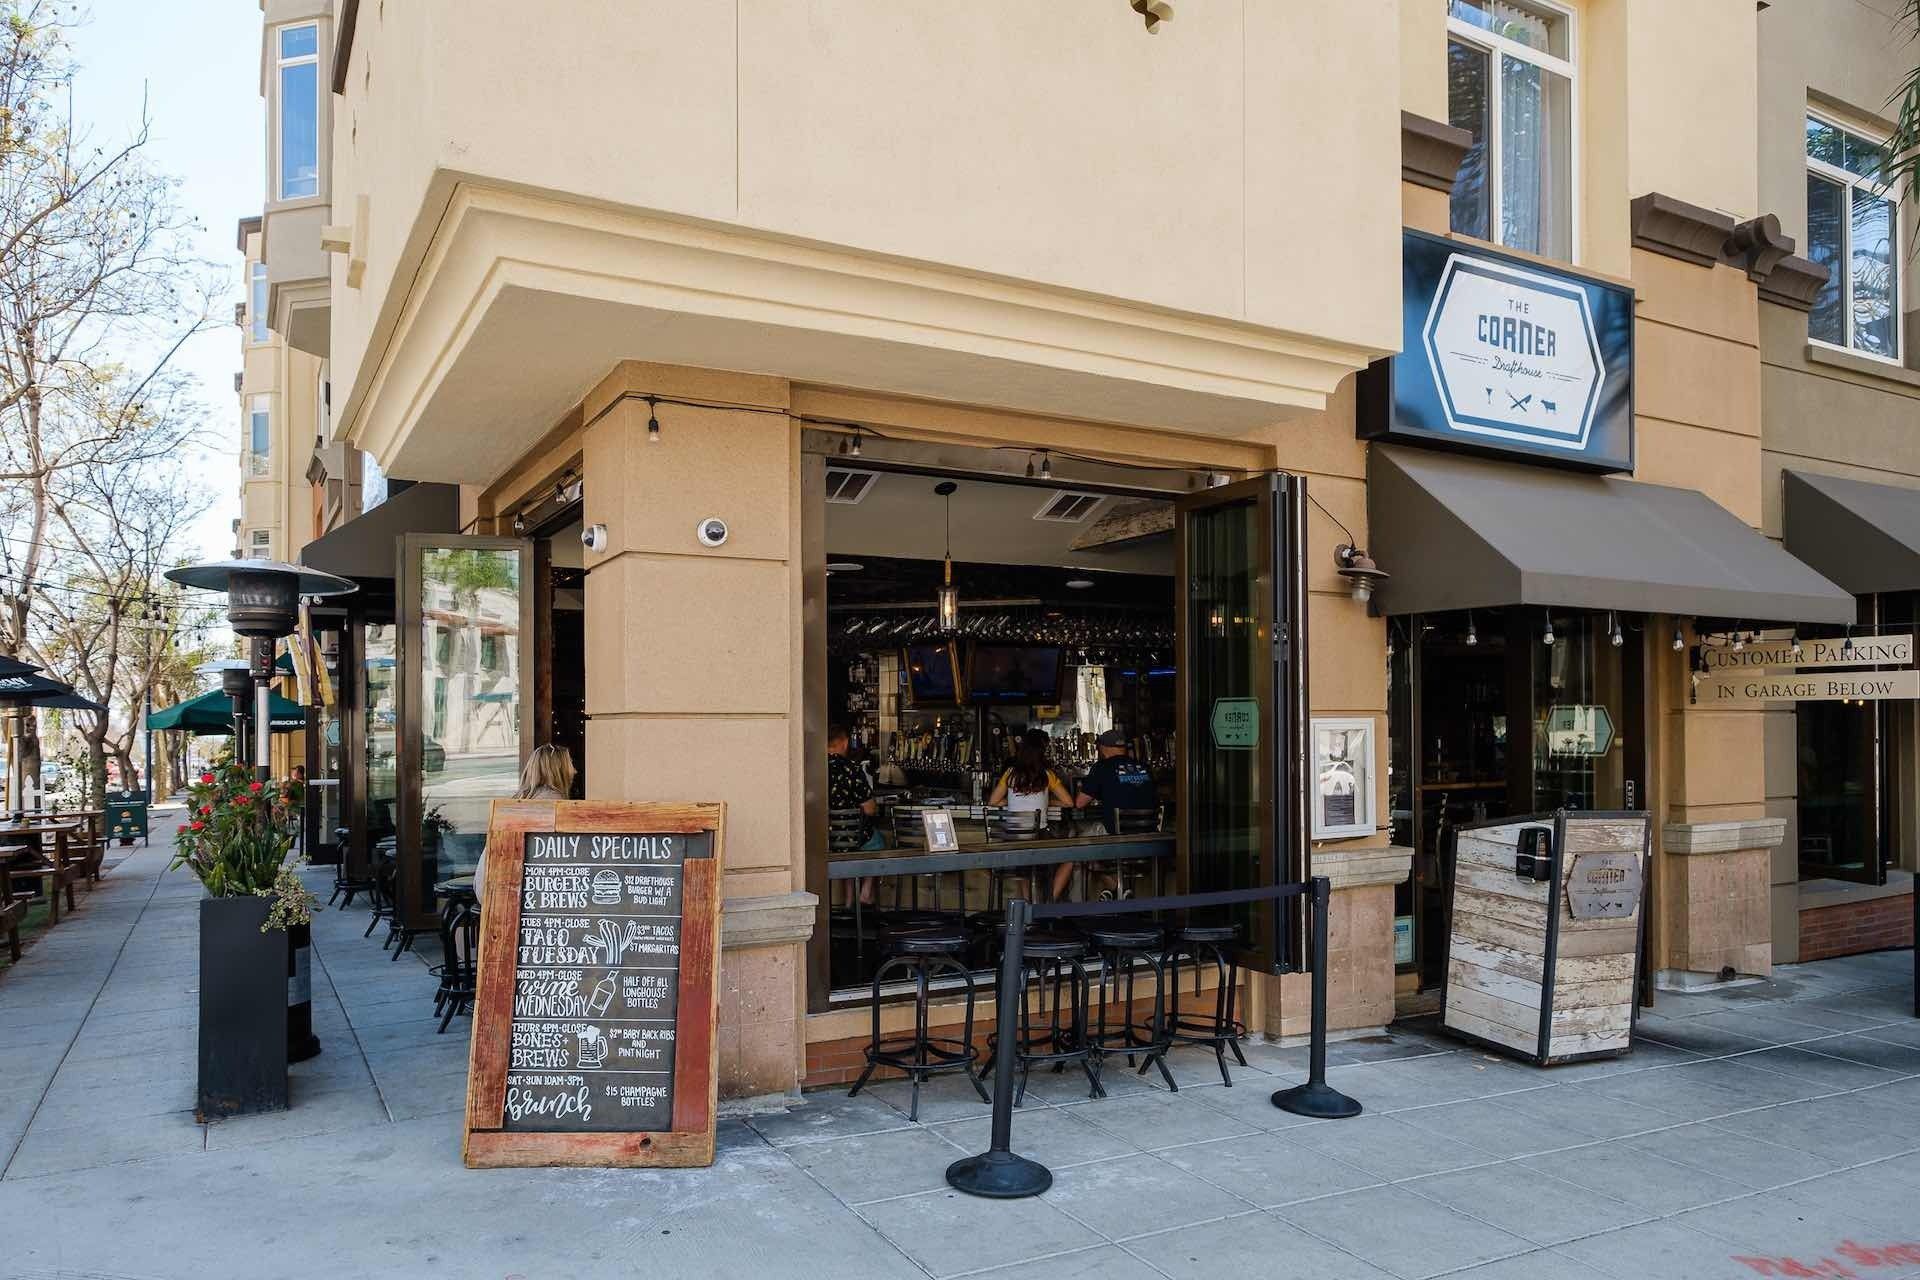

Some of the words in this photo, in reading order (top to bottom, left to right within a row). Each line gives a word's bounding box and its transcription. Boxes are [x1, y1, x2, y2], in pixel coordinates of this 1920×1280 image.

[1508, 299, 1529, 313] THE
[1479, 315, 1556, 357] CORNER
[1492, 355, 1543, 378] Drafthouse
[1704, 648, 1805, 668] CUSTOMER
[1814, 643, 1907, 662] PARKING
[1718, 684, 1735, 698] IN
[1745, 683, 1816, 697] GARAGE
[1828, 682, 1894, 696] BELOW
[534, 836, 580, 858] DAILY
[591, 836, 672, 859] SPECIALS
[525, 867, 546, 876] MON
[524, 877, 590, 891] BURGERS
[635, 876, 675, 886] DRAFTHOUSE
[628, 886, 652, 895] BURGER
[655, 887, 664, 897] W/
[666, 887, 671, 896] A
[524, 892, 536, 909] &
[540, 892, 588, 908] BREWS
[634, 895, 647, 904] BUD
[649, 897, 667, 906] LIGHT
[521, 918, 541, 927] TUES
[652, 926, 674, 936] TACOS
[522, 929, 569, 946] TACO
[639, 944, 679, 954] MARGARITAS
[519, 947, 599, 964] TUESDAY
[517, 970, 535, 979] WED
[623, 976, 639, 986] HALF
[642, 976, 655, 986] OFF
[657, 978, 668, 987] ALL
[519, 979, 579, 996] wine
[623, 988, 667, 998] LONGHOUSE
[516, 995, 588, 1016] WEDNESDAY
[627, 998, 658, 1008] BOTTLES
[512, 1023, 540, 1032] THURS
[623, 1029, 640, 1039] BABY
[642, 1030, 659, 1040] BACK
[660, 1030, 675, 1040] RIBS
[632, 1040, 646, 1048] AND
[512, 1049, 569, 1067] BREWS
[619, 1048, 635, 1056] PINT
[636, 1050, 661, 1059] NIGHT
[606, 1085, 618, 1096] $15
[620, 1086, 667, 1097] CHAMPAGNE
[505, 1086, 591, 1121] brunch
[621, 1097, 655, 1107] BOTTLES
